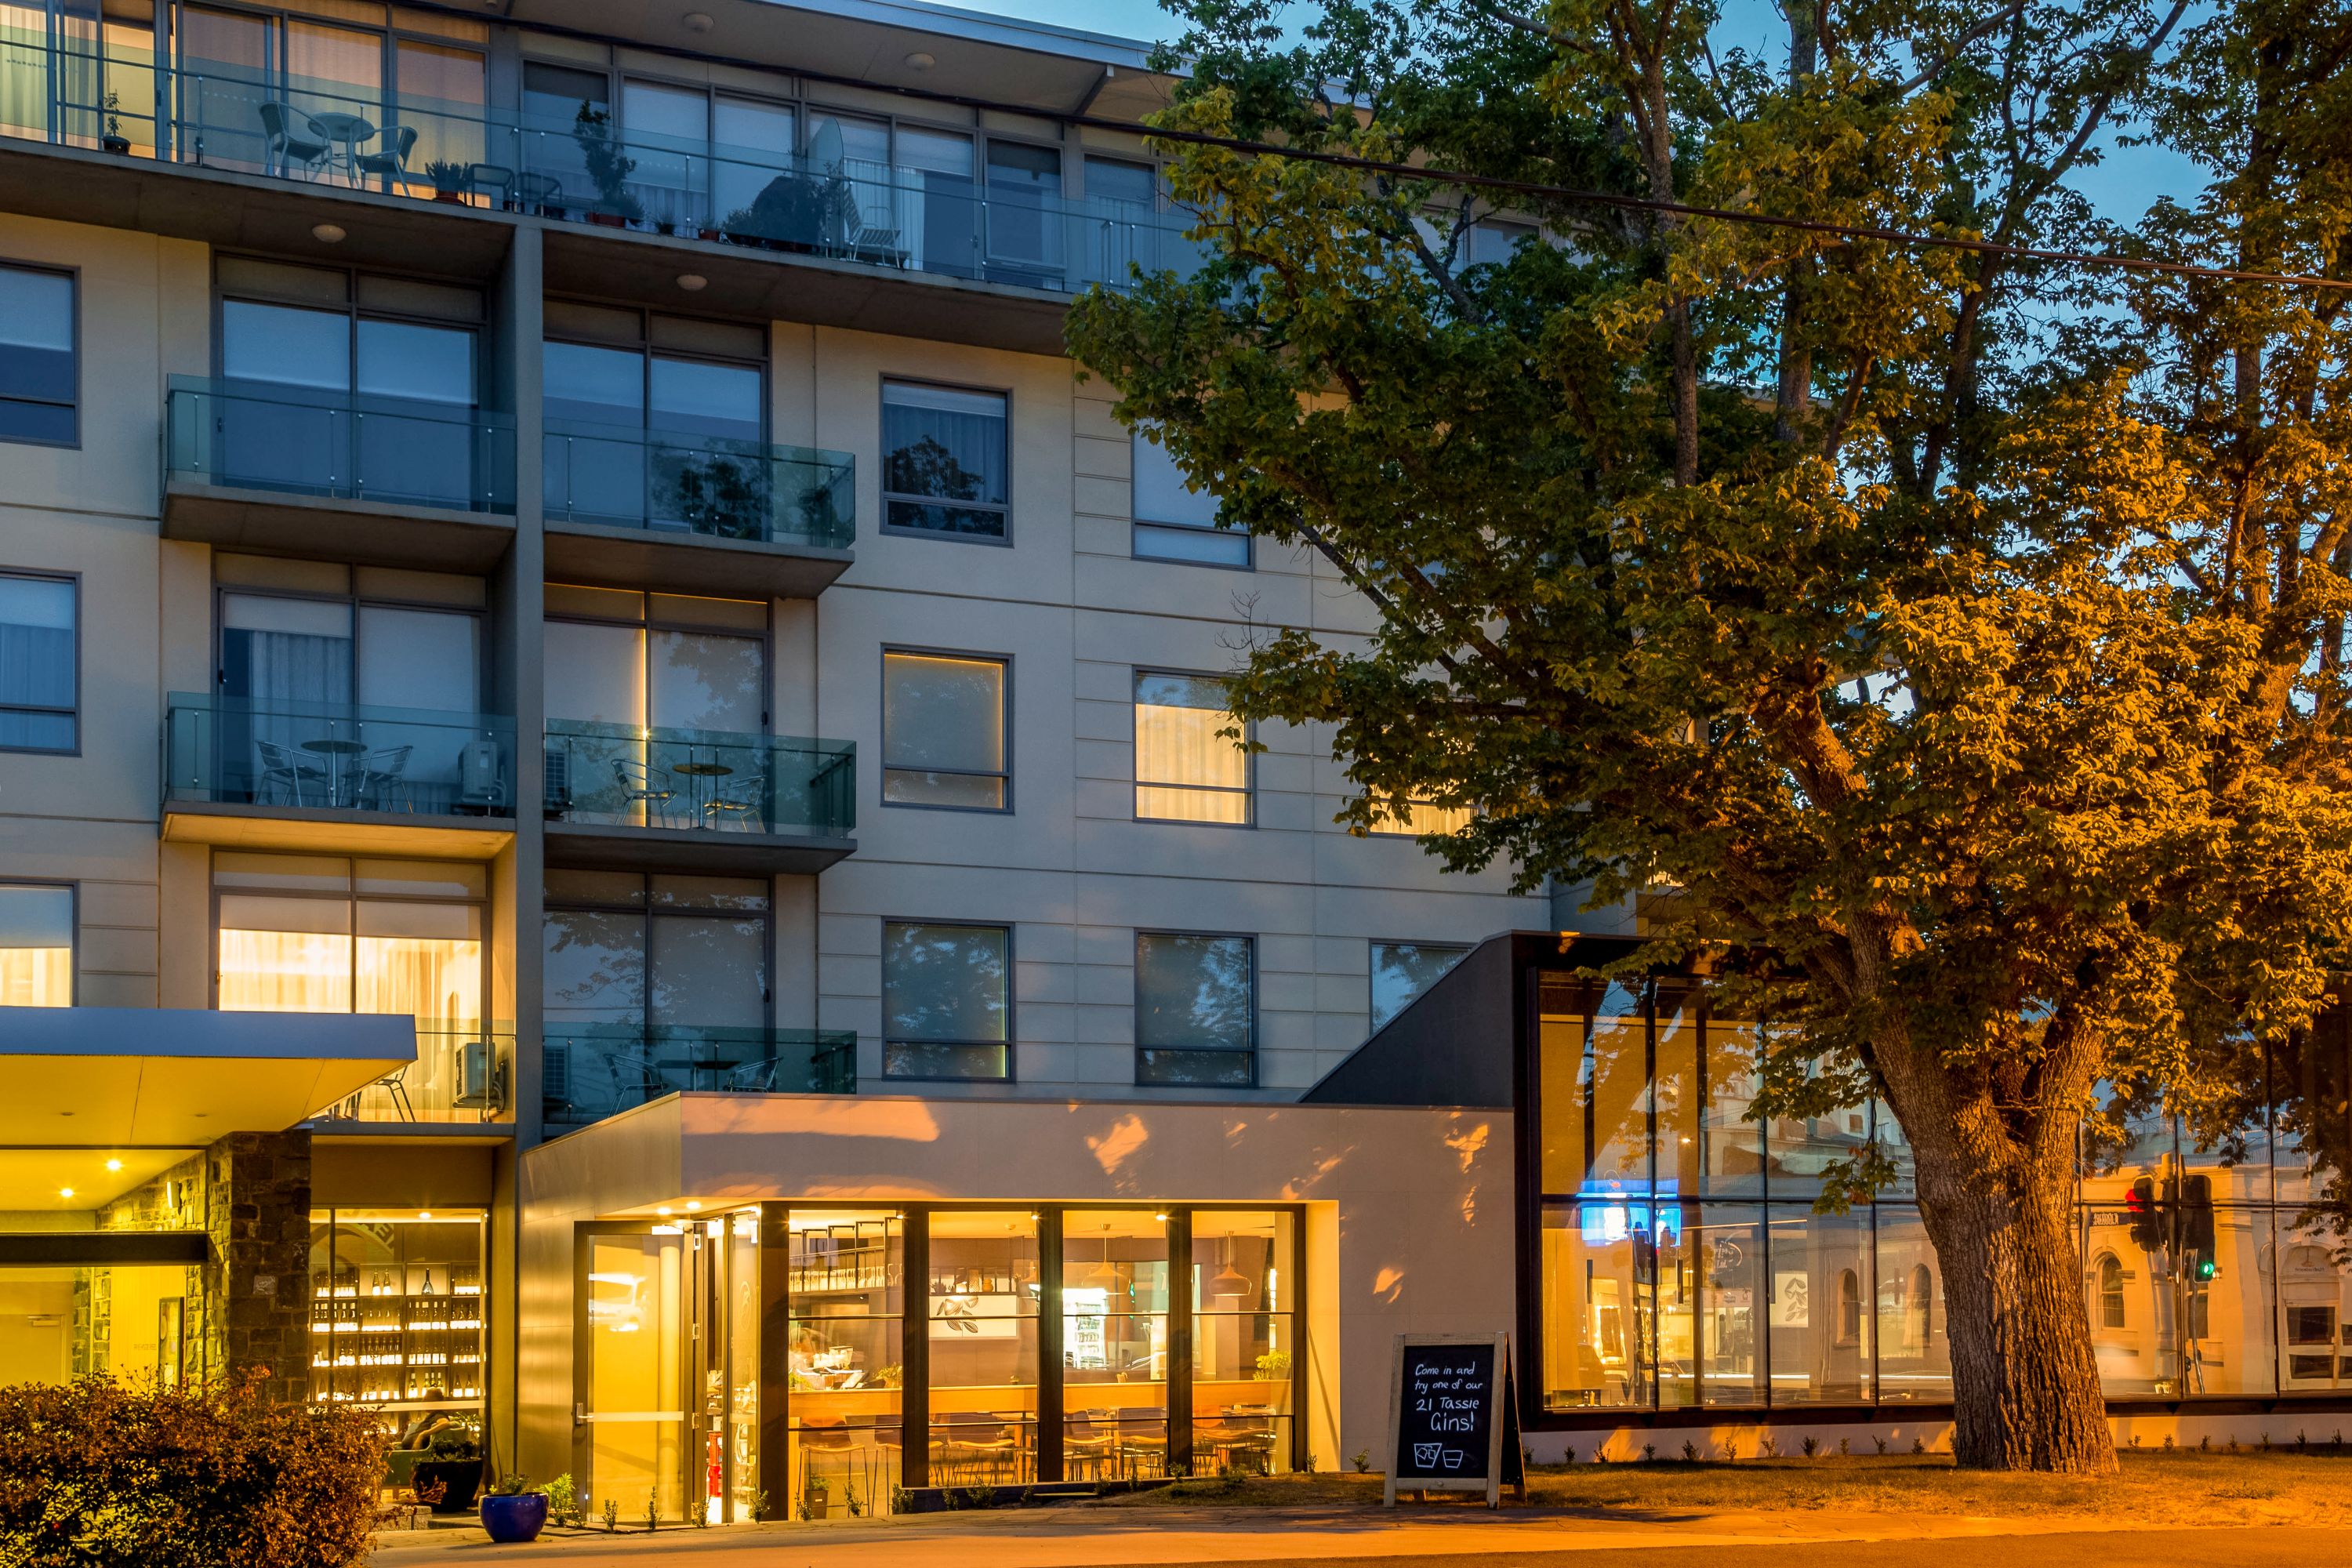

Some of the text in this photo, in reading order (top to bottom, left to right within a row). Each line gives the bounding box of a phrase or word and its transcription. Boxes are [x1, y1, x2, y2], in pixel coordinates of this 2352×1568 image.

[1415, 1361, 1475, 1376] Come in and
[1414, 1379, 1428, 1394] try
[1451, 1378, 1462, 1389] of
[1416, 1396, 1479, 1411] 21 Tassie
[1431, 1410, 1474, 1432] Gins!
